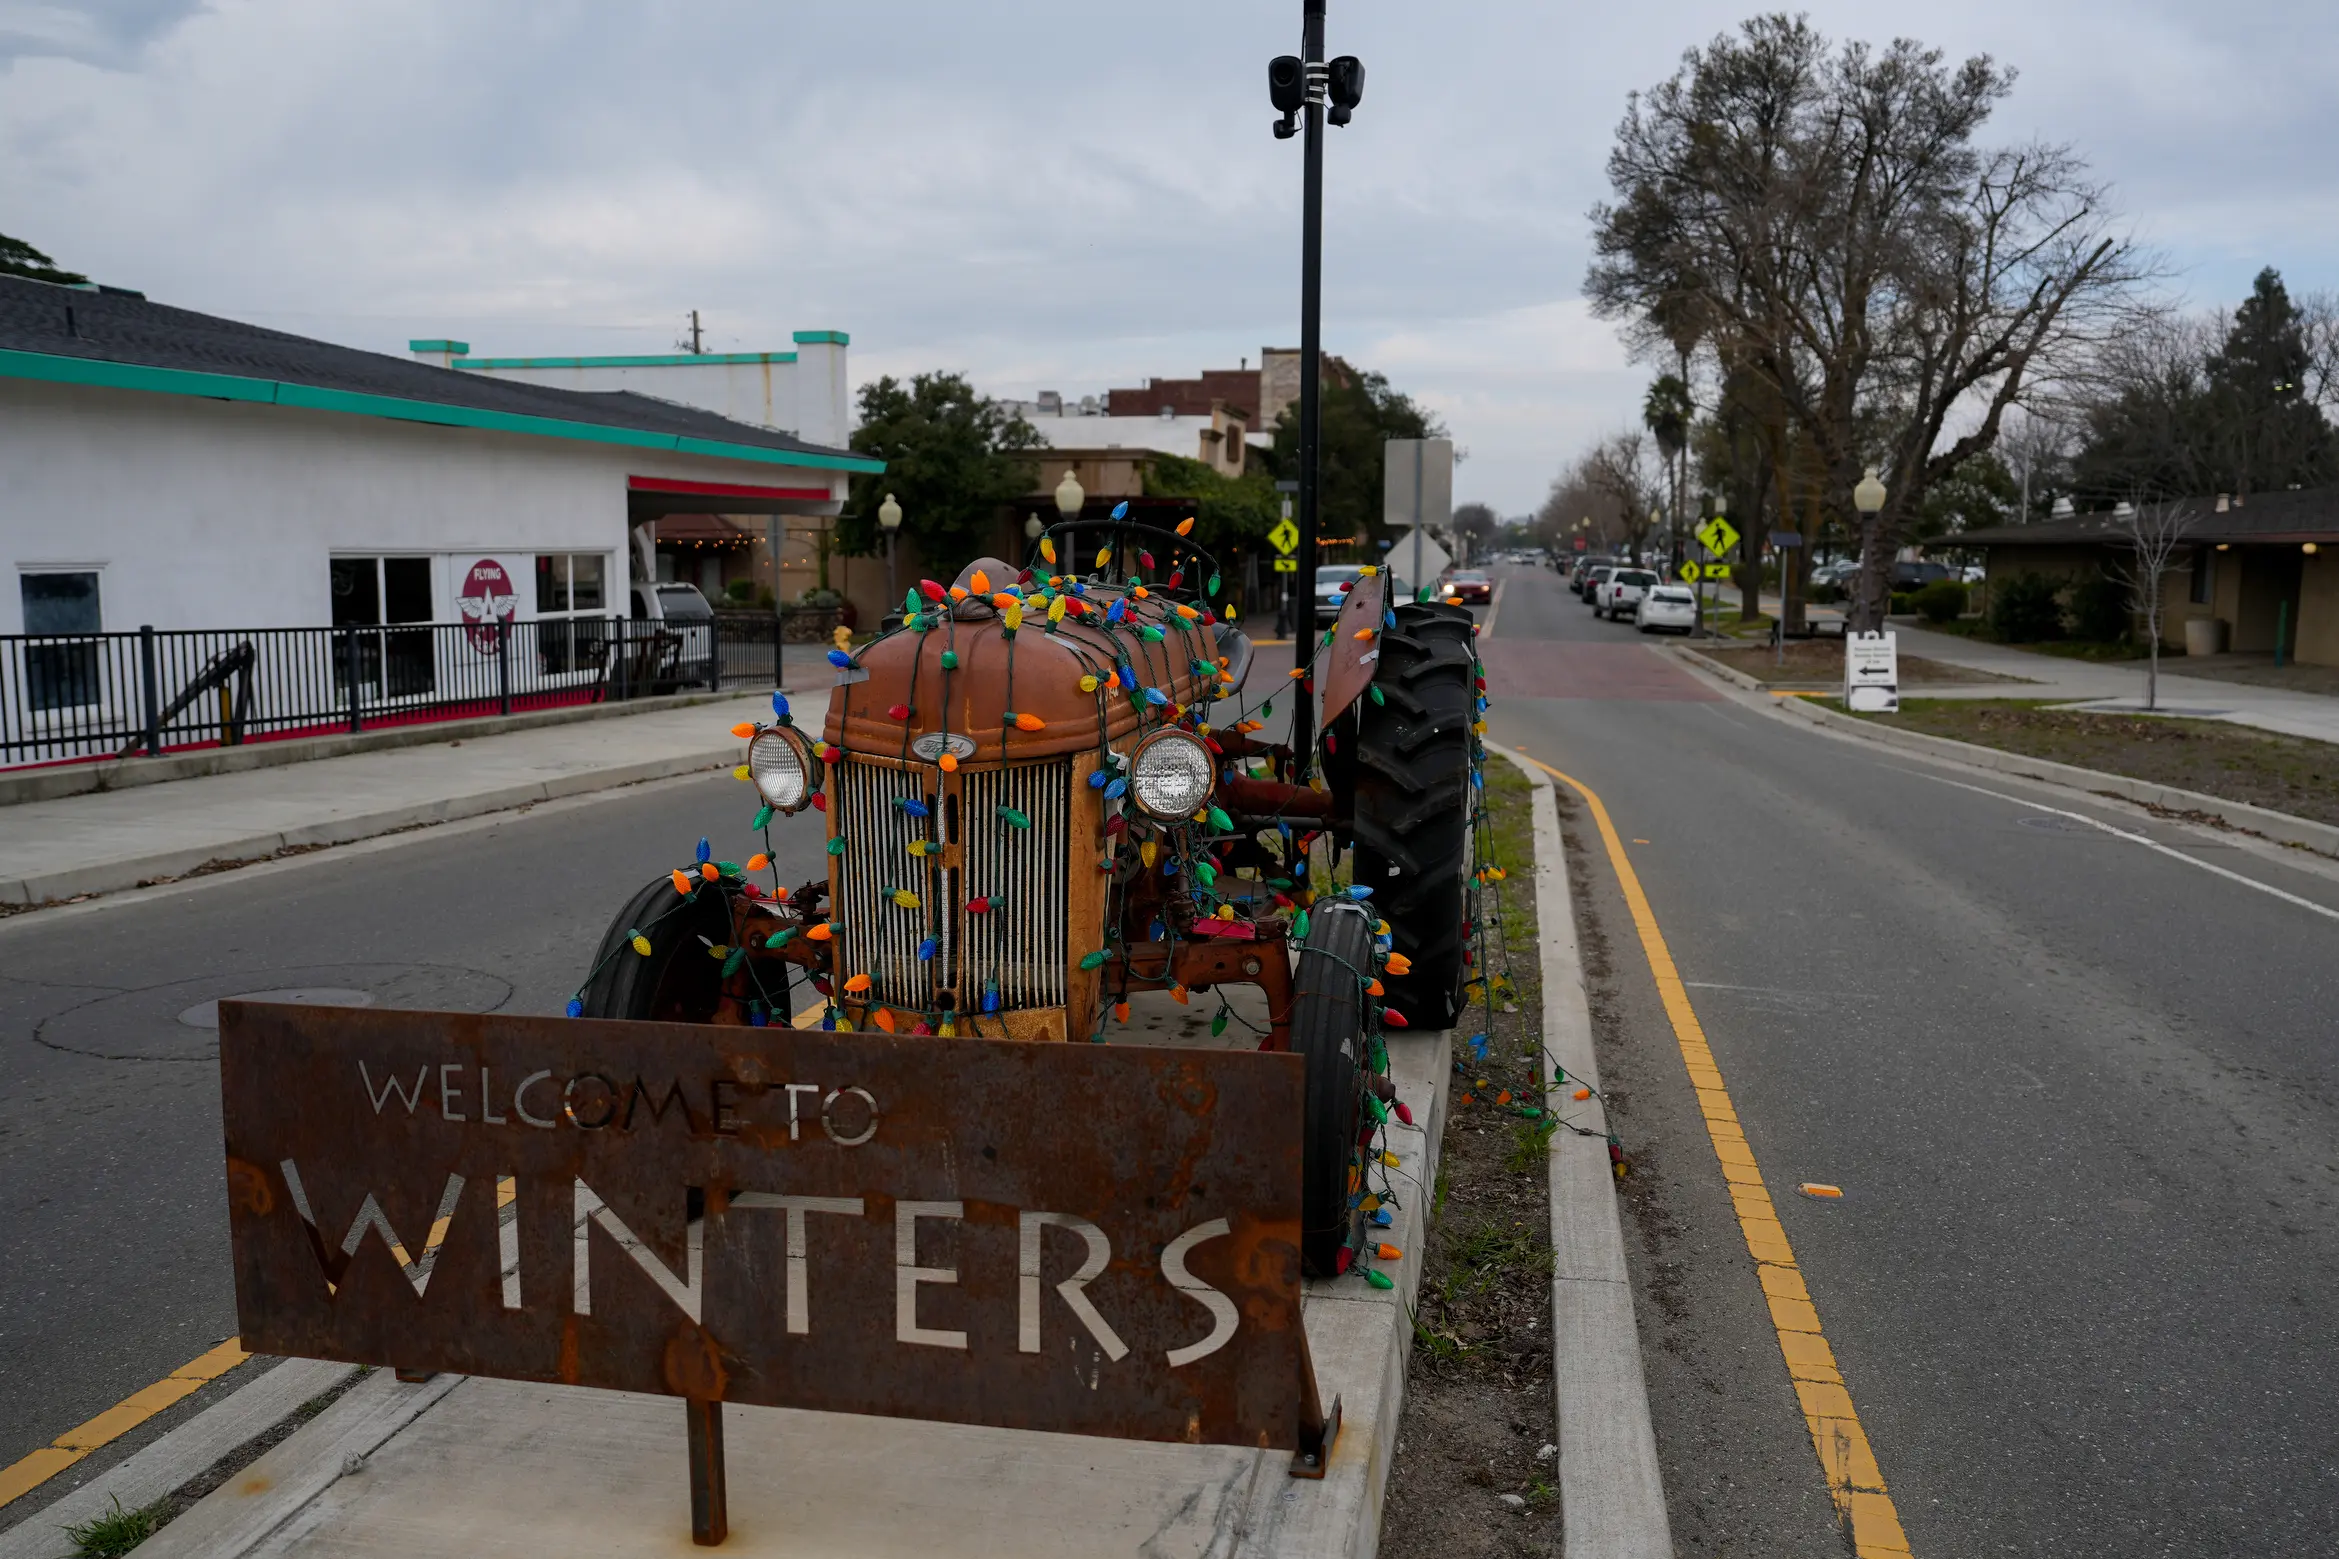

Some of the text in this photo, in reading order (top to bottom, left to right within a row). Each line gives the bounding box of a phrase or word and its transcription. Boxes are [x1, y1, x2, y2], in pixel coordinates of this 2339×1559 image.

[474, 568, 501, 580] FLYING
[358, 1059, 879, 1146] WELCOME TO
[280, 1158, 1240, 1367] WINTERS
